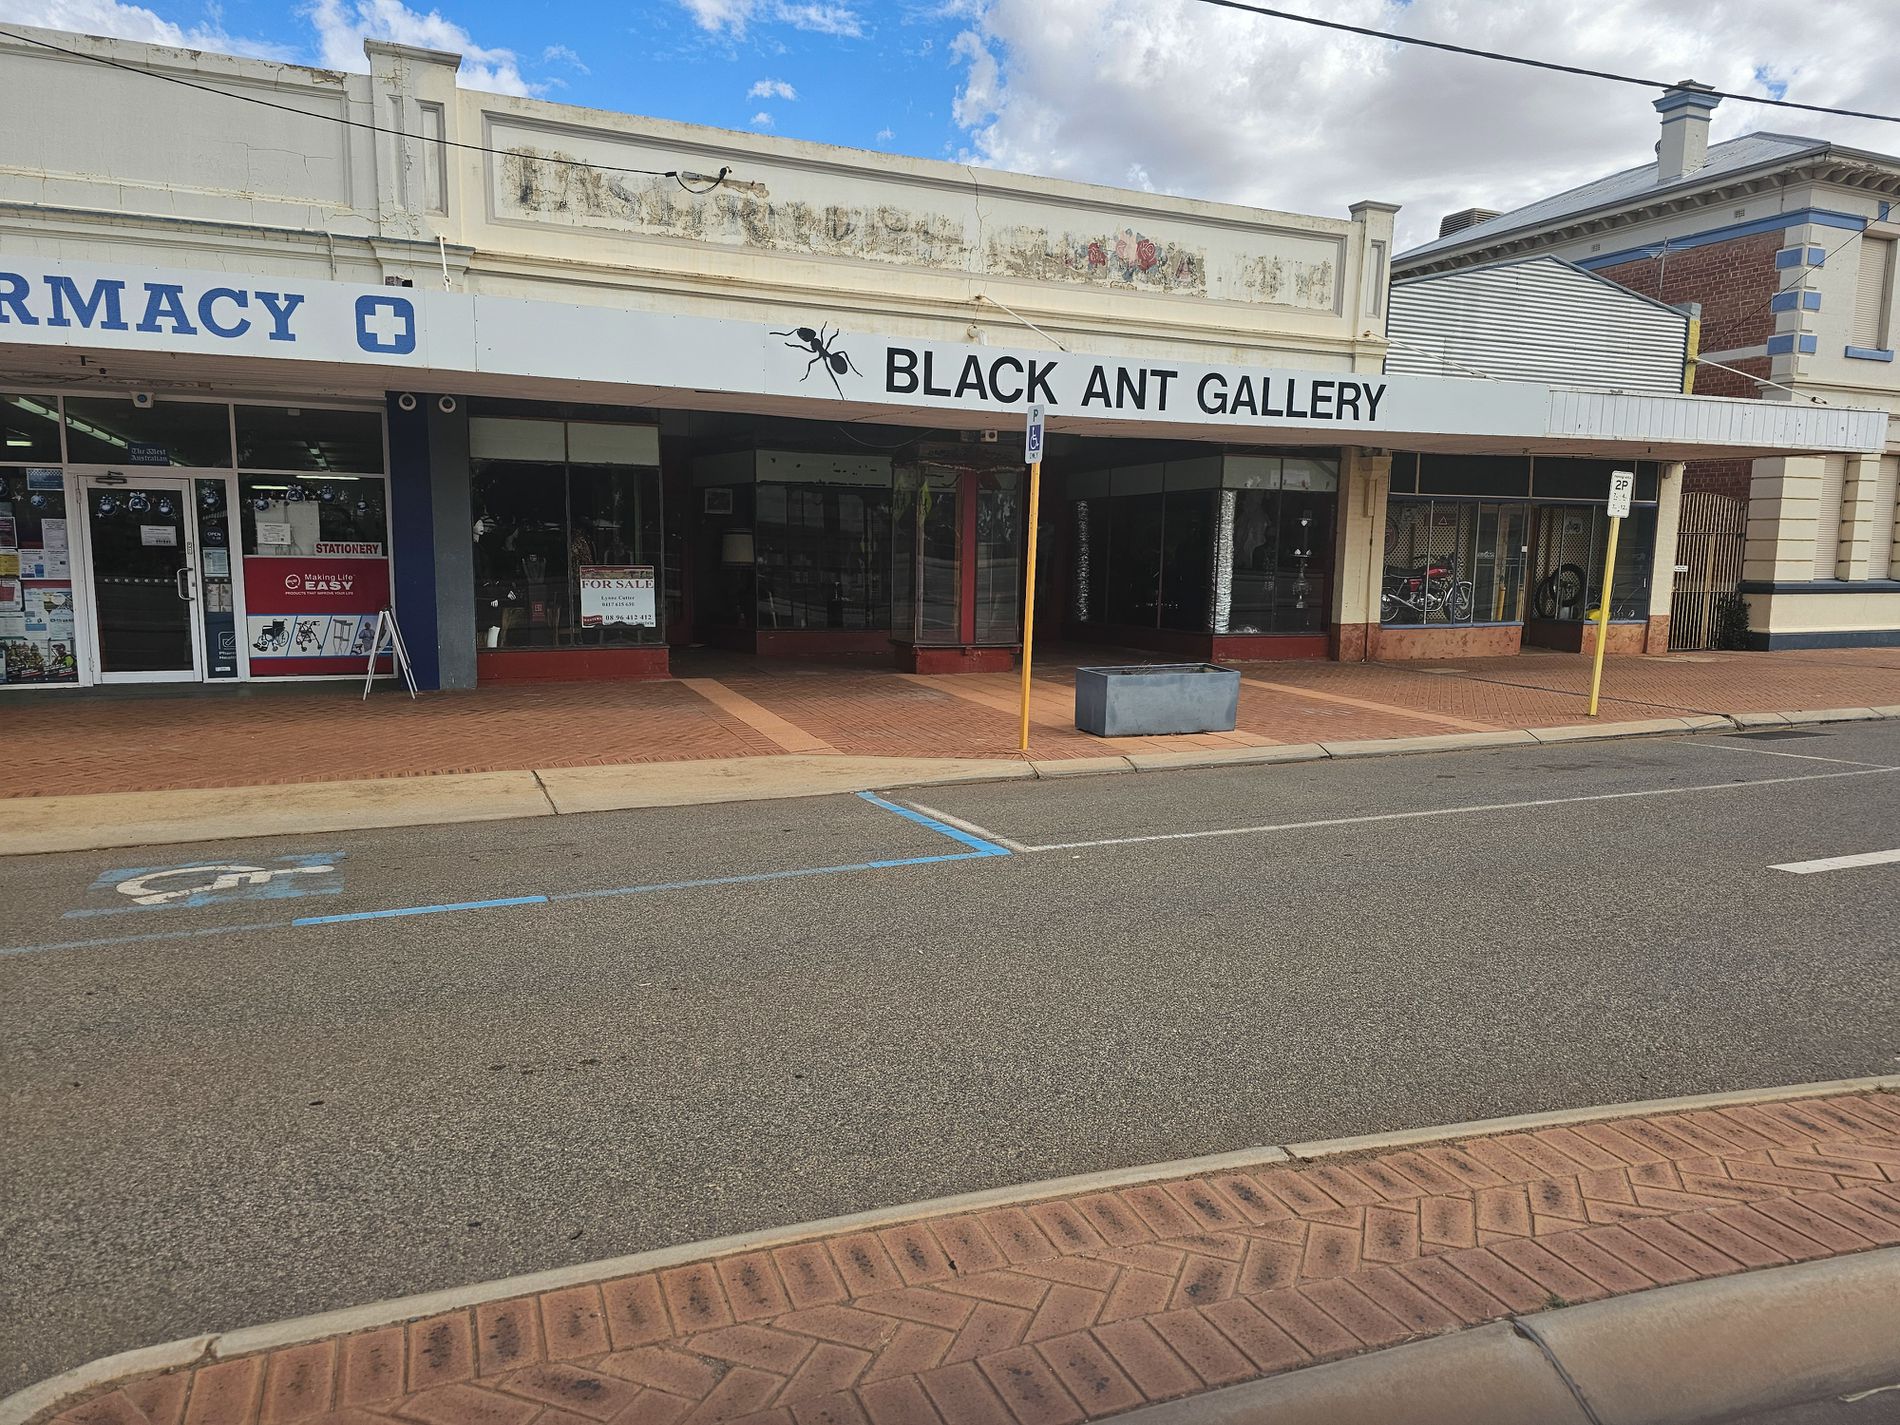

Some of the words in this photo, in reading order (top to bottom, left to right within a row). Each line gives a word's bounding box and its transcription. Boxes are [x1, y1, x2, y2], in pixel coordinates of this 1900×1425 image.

[885, 347, 1058, 404] BLACK
[1081, 365, 1178, 411] ANT
[1197, 372, 1387, 422] GALLERY
[1032, 409, 1038, 422] P
[131, 454, 168, 462] Australian
[1615, 480, 1629, 490] 2P
[316, 543, 379, 554] STATIONERY
[304, 574, 336, 582] Making
[305, 581, 353, 590] EASY
[582, 580, 612, 589] FOR
[616, 580, 654, 589] SALE
